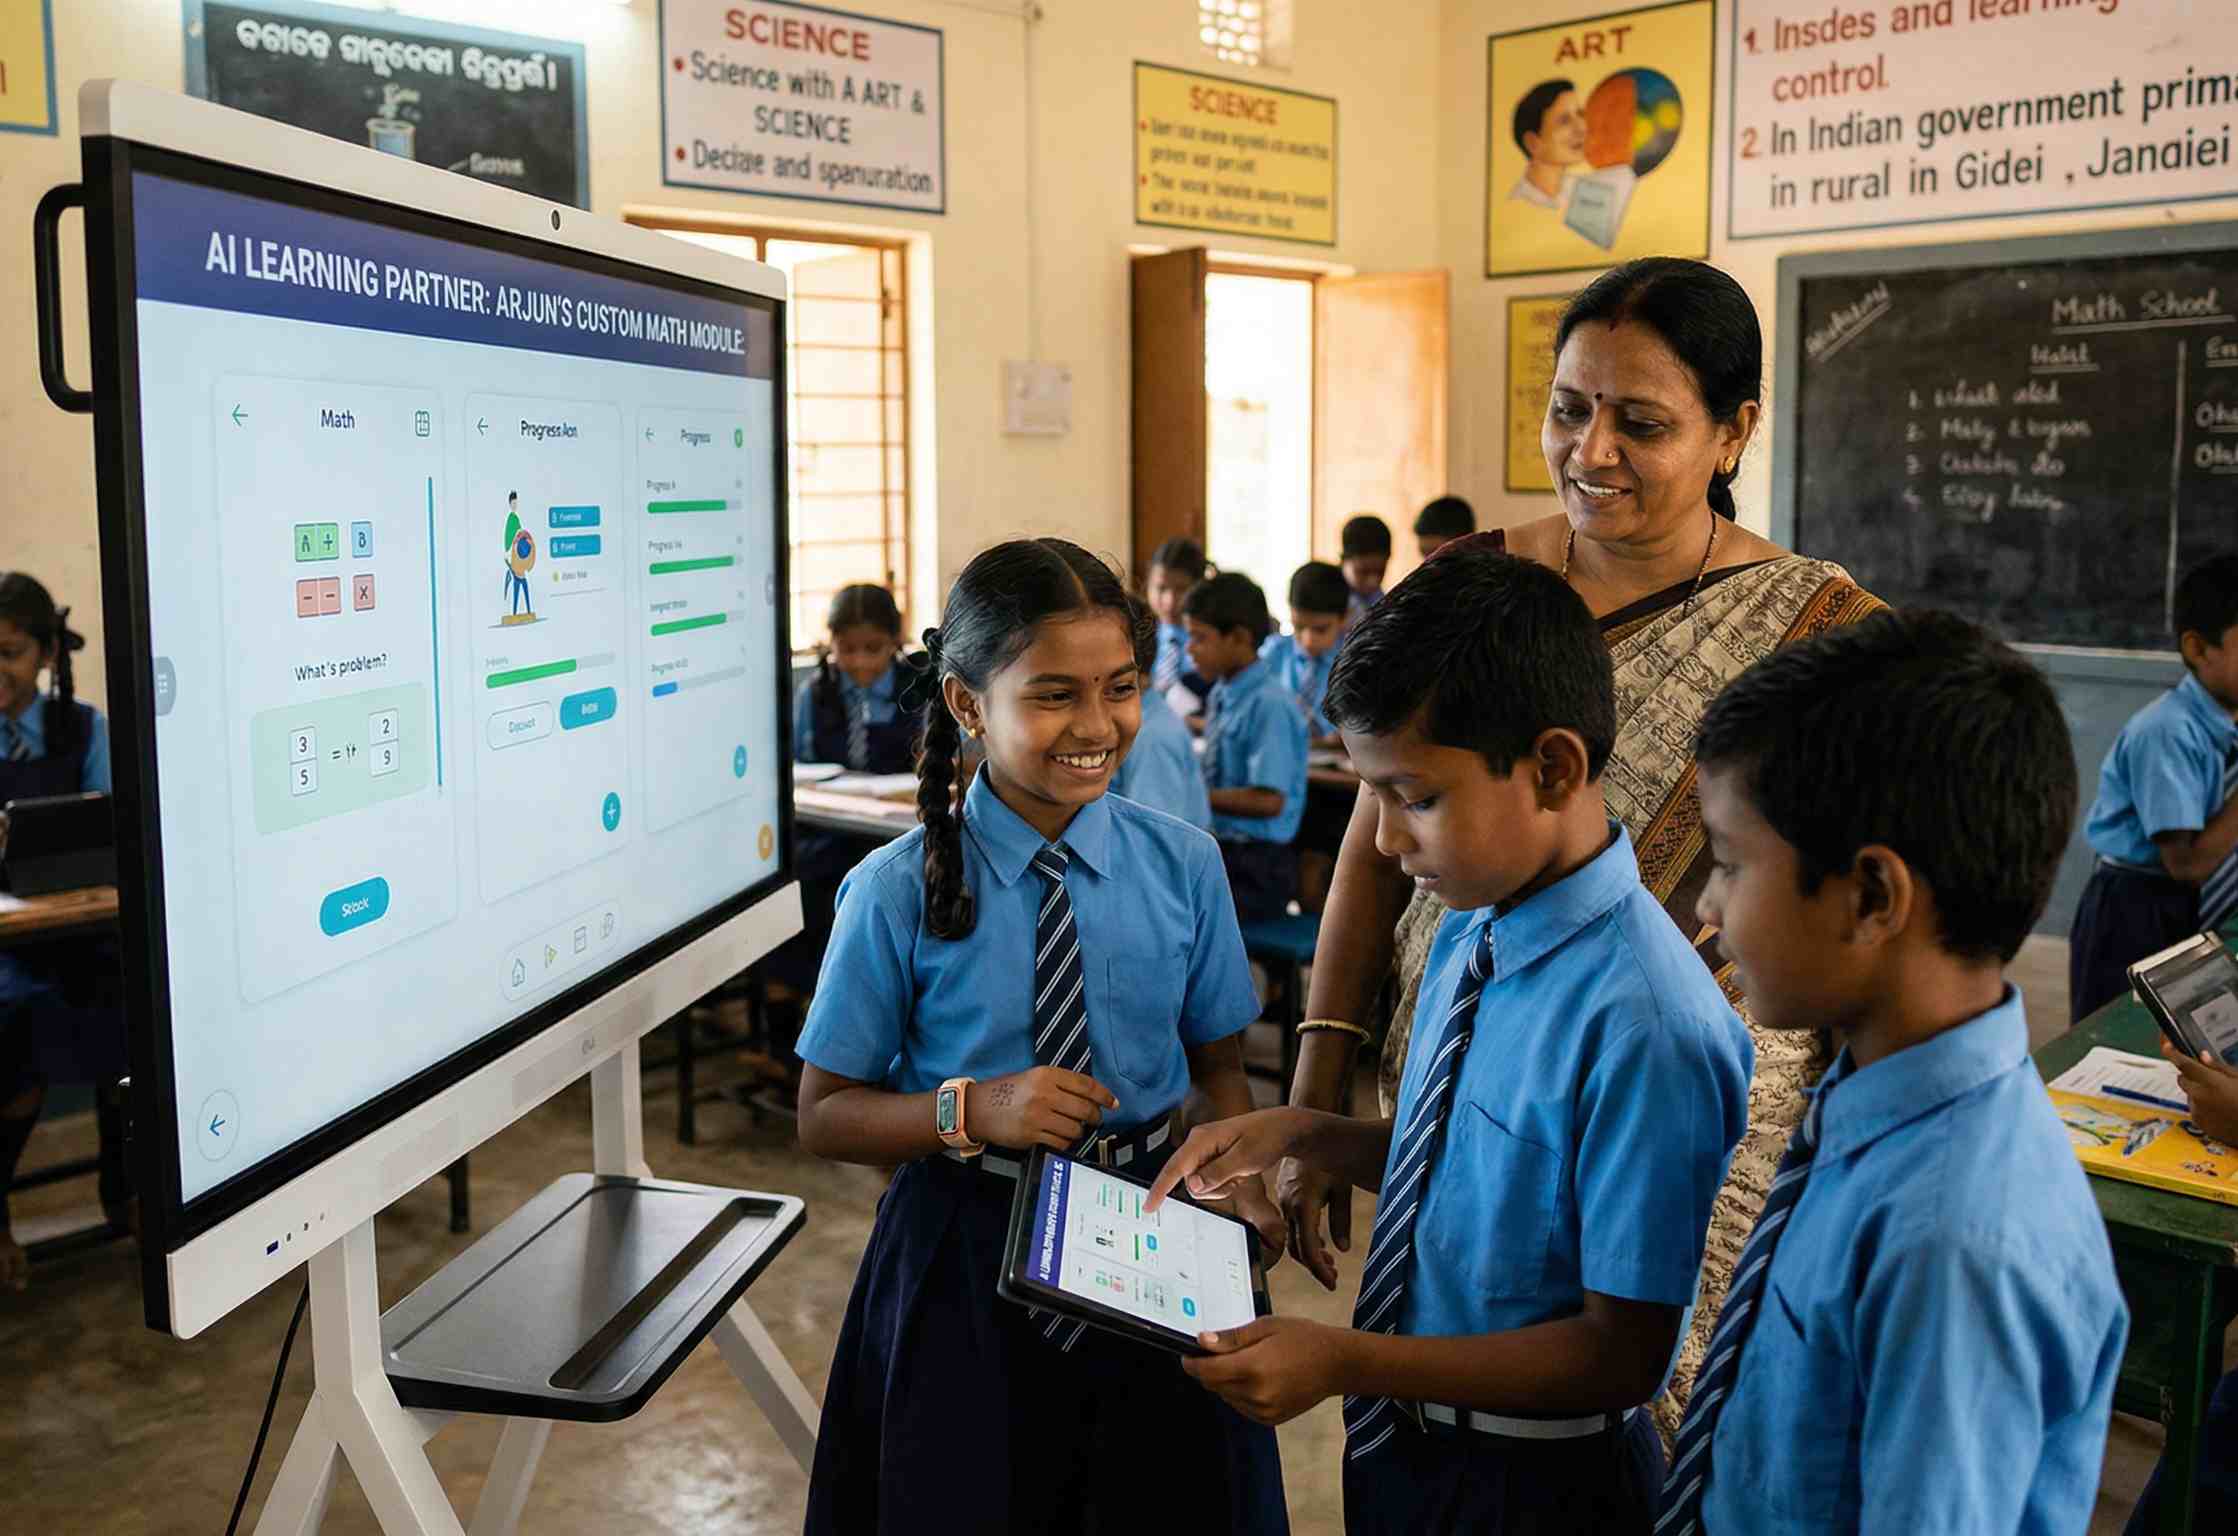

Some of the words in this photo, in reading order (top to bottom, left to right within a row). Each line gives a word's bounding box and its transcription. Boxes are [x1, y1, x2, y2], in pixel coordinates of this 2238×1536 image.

[725, 9, 871, 61] SCIENCE
[1774, 8, 1877, 51] Insdes
[1891, 0, 1953, 33] and
[1554, 26, 1633, 64] ART
[691, 50, 779, 91] Science
[787, 69, 834, 100] with
[842, 77, 856, 103] A
[862, 81, 902, 109] ART
[1190, 85, 1278, 125] SCIENCE
[1771, 122, 1796, 155] In
[1809, 111, 1903, 151] Indian
[1917, 77, 2124, 149] government
[2143, 66, 2238, 125] prim
[755, 105, 851, 144] SCIENCE
[774, 153, 810, 180] and
[1771, 175, 1796, 207] in
[1813, 162, 1890, 203] rural
[1910, 159, 1938, 195] in
[205, 231, 237, 275] AI
[245, 237, 379, 297] LEARNING
[385, 264, 490, 314] PARTNER:
[496, 285, 572, 328] ARJUN'S
[577, 301, 643, 340] CUSTOM
[647, 314, 687, 346] MATH
[2052, 295, 2127, 324] Math
[2139, 287, 2222, 319] School
[321, 409, 355, 429] Math
[339, 653, 386, 678] problem?
[299, 736, 308, 753] 3
[382, 719, 390, 734] 2
[300, 769, 309, 785] 5
